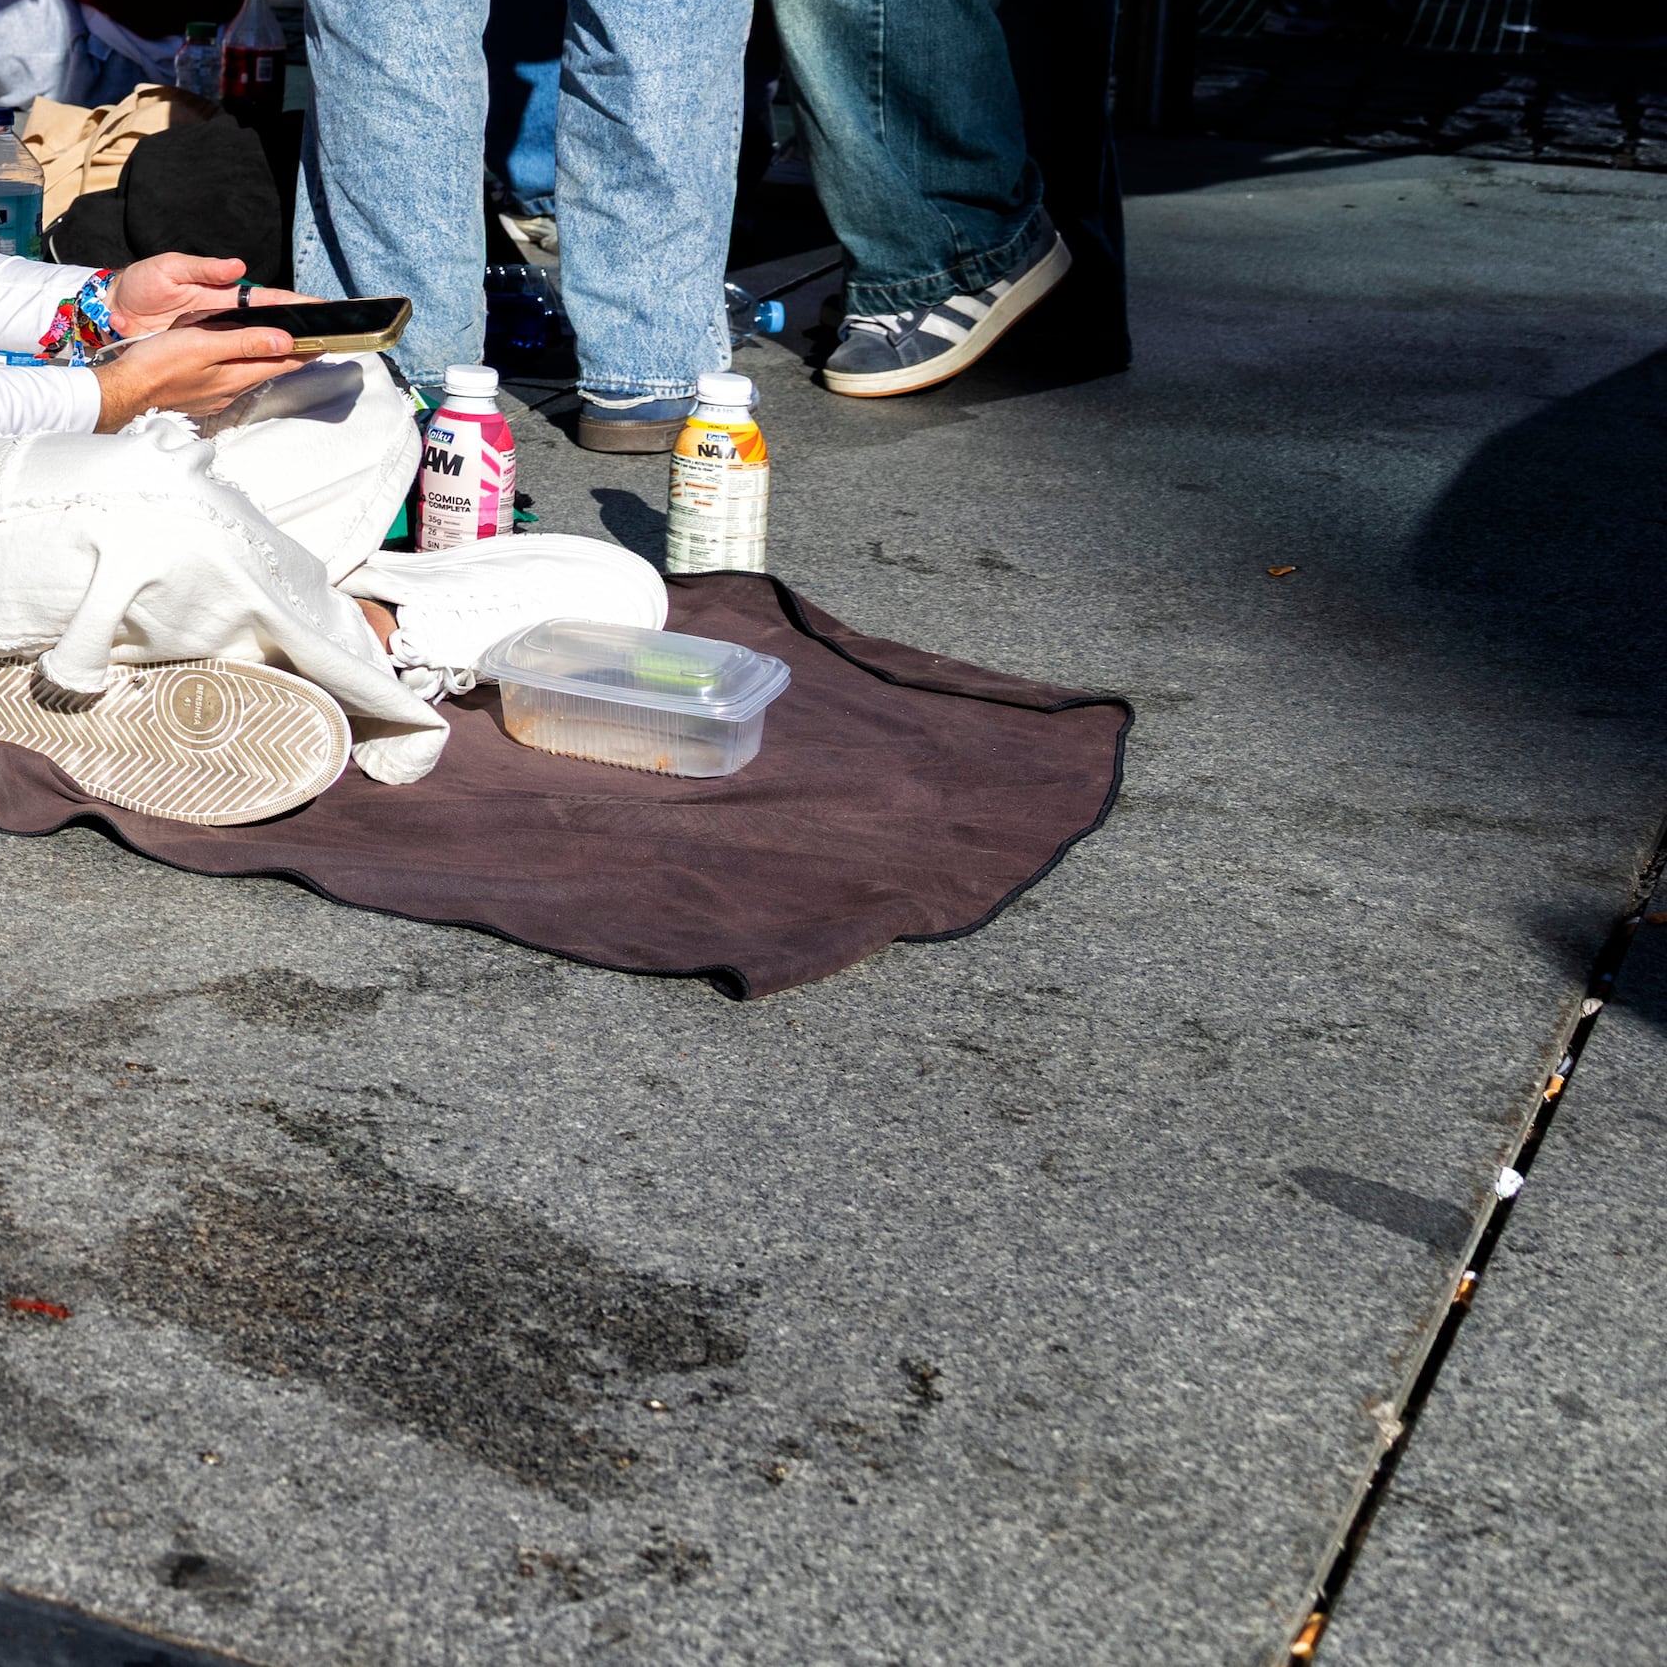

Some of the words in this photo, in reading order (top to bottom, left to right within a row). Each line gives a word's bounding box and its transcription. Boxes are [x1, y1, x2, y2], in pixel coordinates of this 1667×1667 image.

[422, 445, 465, 476] AM
[428, 491, 471, 506] COMIDA
[428, 501, 471, 513] COMPLETA
[193, 683, 204, 726] BERSHKA
